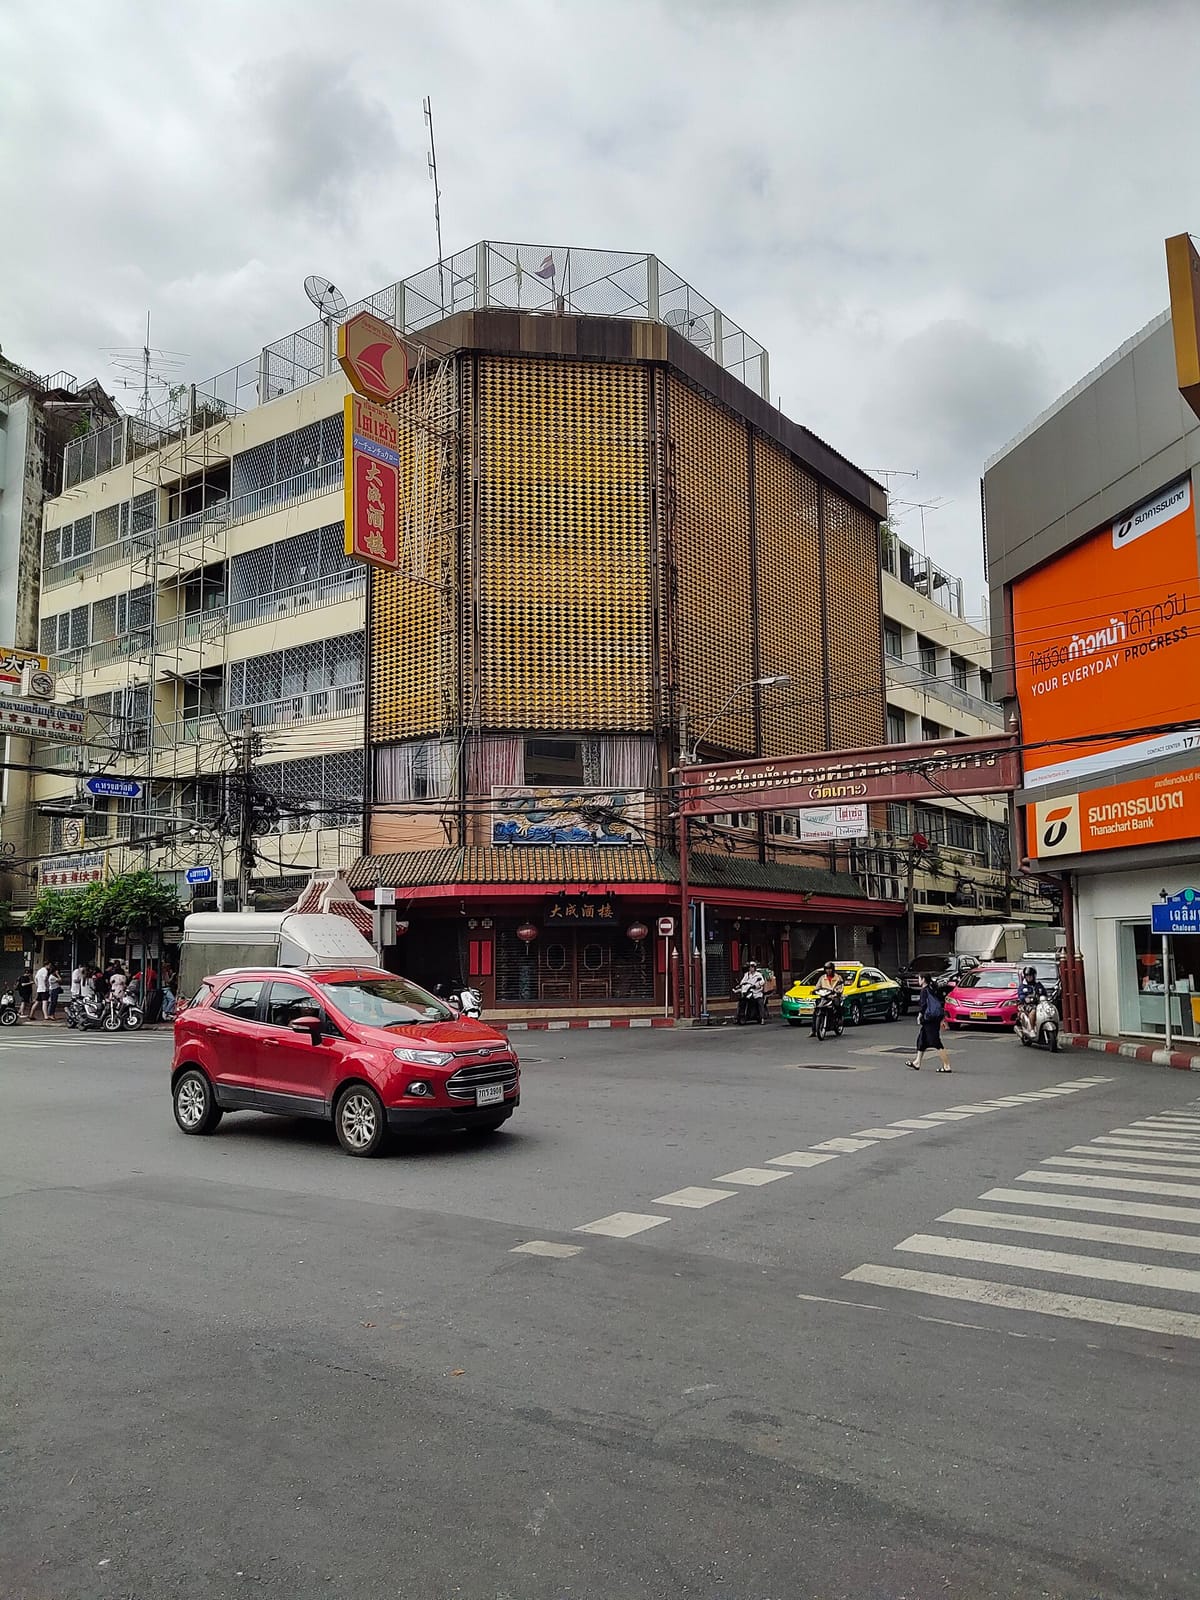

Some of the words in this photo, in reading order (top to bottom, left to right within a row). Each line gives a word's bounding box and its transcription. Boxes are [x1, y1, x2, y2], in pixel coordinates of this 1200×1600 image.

[1031, 676, 1059, 697] YOUR
[1061, 653, 1119, 687] EVERYDAY
[1124, 626, 1188, 662] PROGRESS
[808, 783, 867, 799] (วัดเกาะ)
[1088, 790, 1184, 824] ธนาคารธนชาต
[1090, 823, 1131, 837] Thanachart
[1131, 817, 1154, 830] Bank
